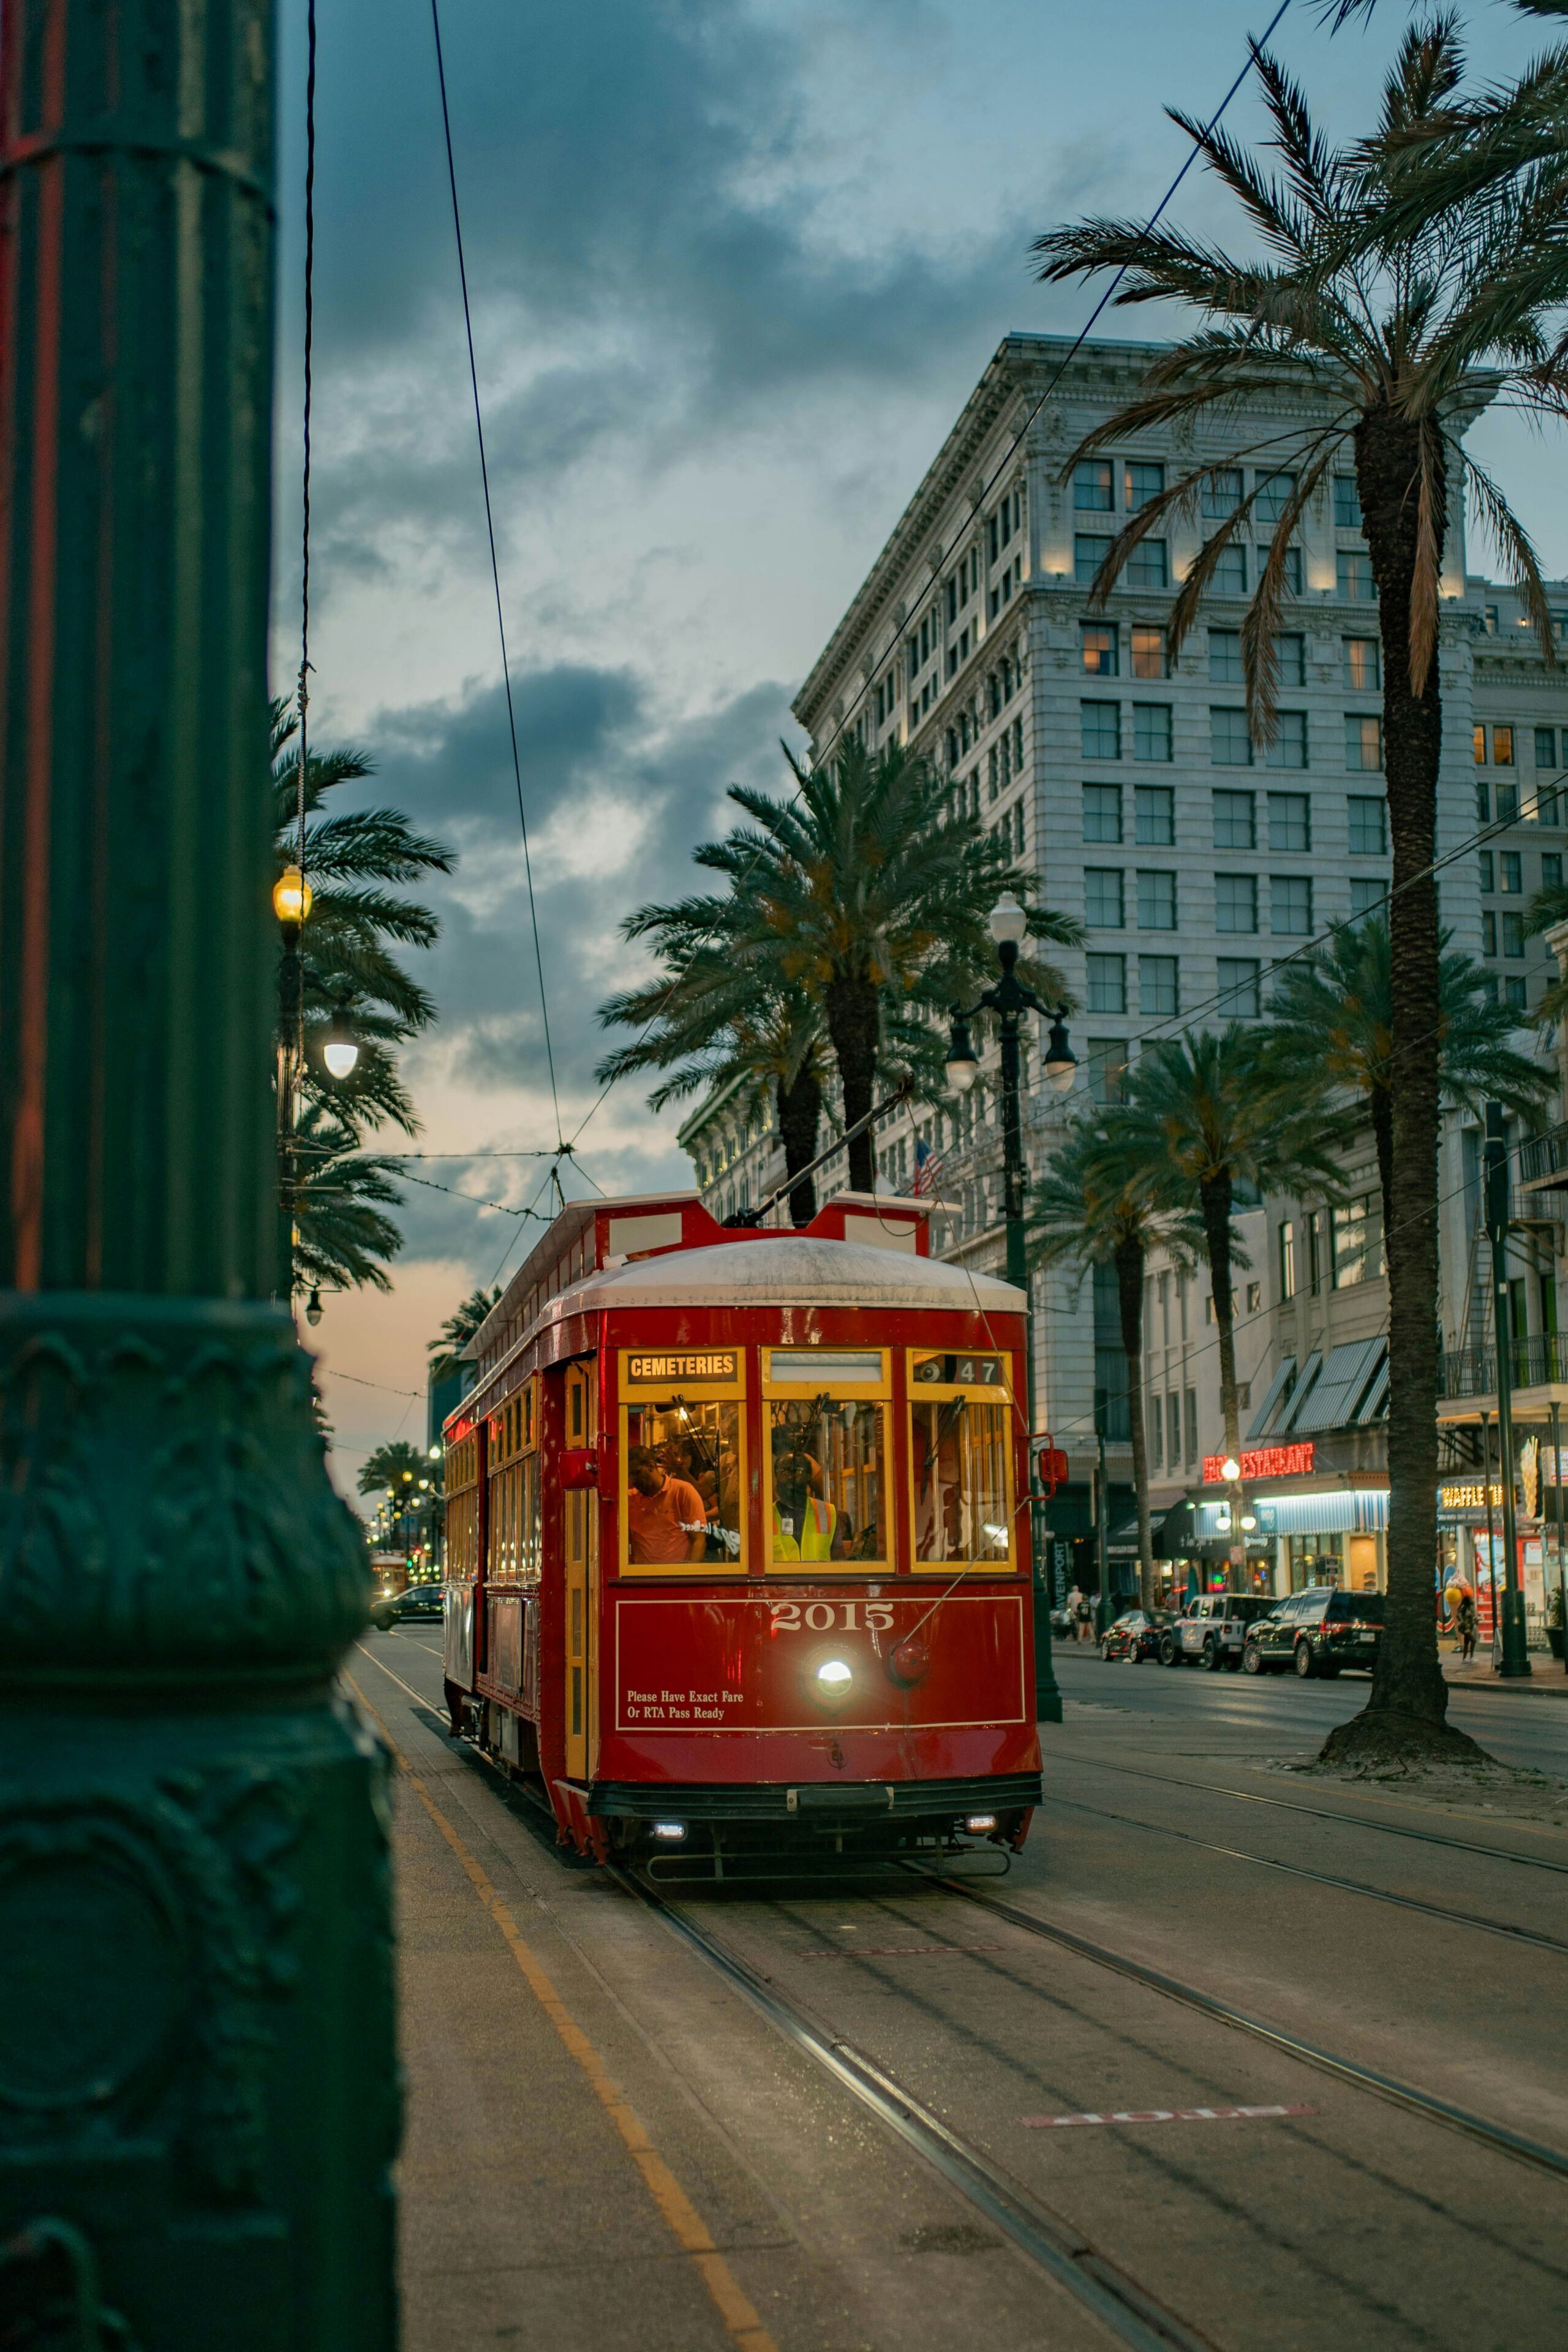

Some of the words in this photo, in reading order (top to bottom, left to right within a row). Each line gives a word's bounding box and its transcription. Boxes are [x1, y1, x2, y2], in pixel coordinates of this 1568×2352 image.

[631, 1355, 734, 1377] CEMETERIES
[961, 1362, 995, 1382] 47
[1239, 1442, 1314, 1480] ESTAURANT
[1441, 1485, 1485, 1509] WAFFLE
[1054, 1541, 1066, 1610] AVENPORT
[771, 1603, 894, 1631] 2015
[627, 1691, 657, 1702] Please
[661, 1691, 685, 1702] Have
[689, 1691, 718, 1702] Exact
[722, 1691, 744, 1702] Fare
[627, 1706, 640, 1718] Or
[644, 1706, 665, 1718] RTA
[669, 1706, 690, 1719] Pass
[694, 1706, 725, 1721] Ready
